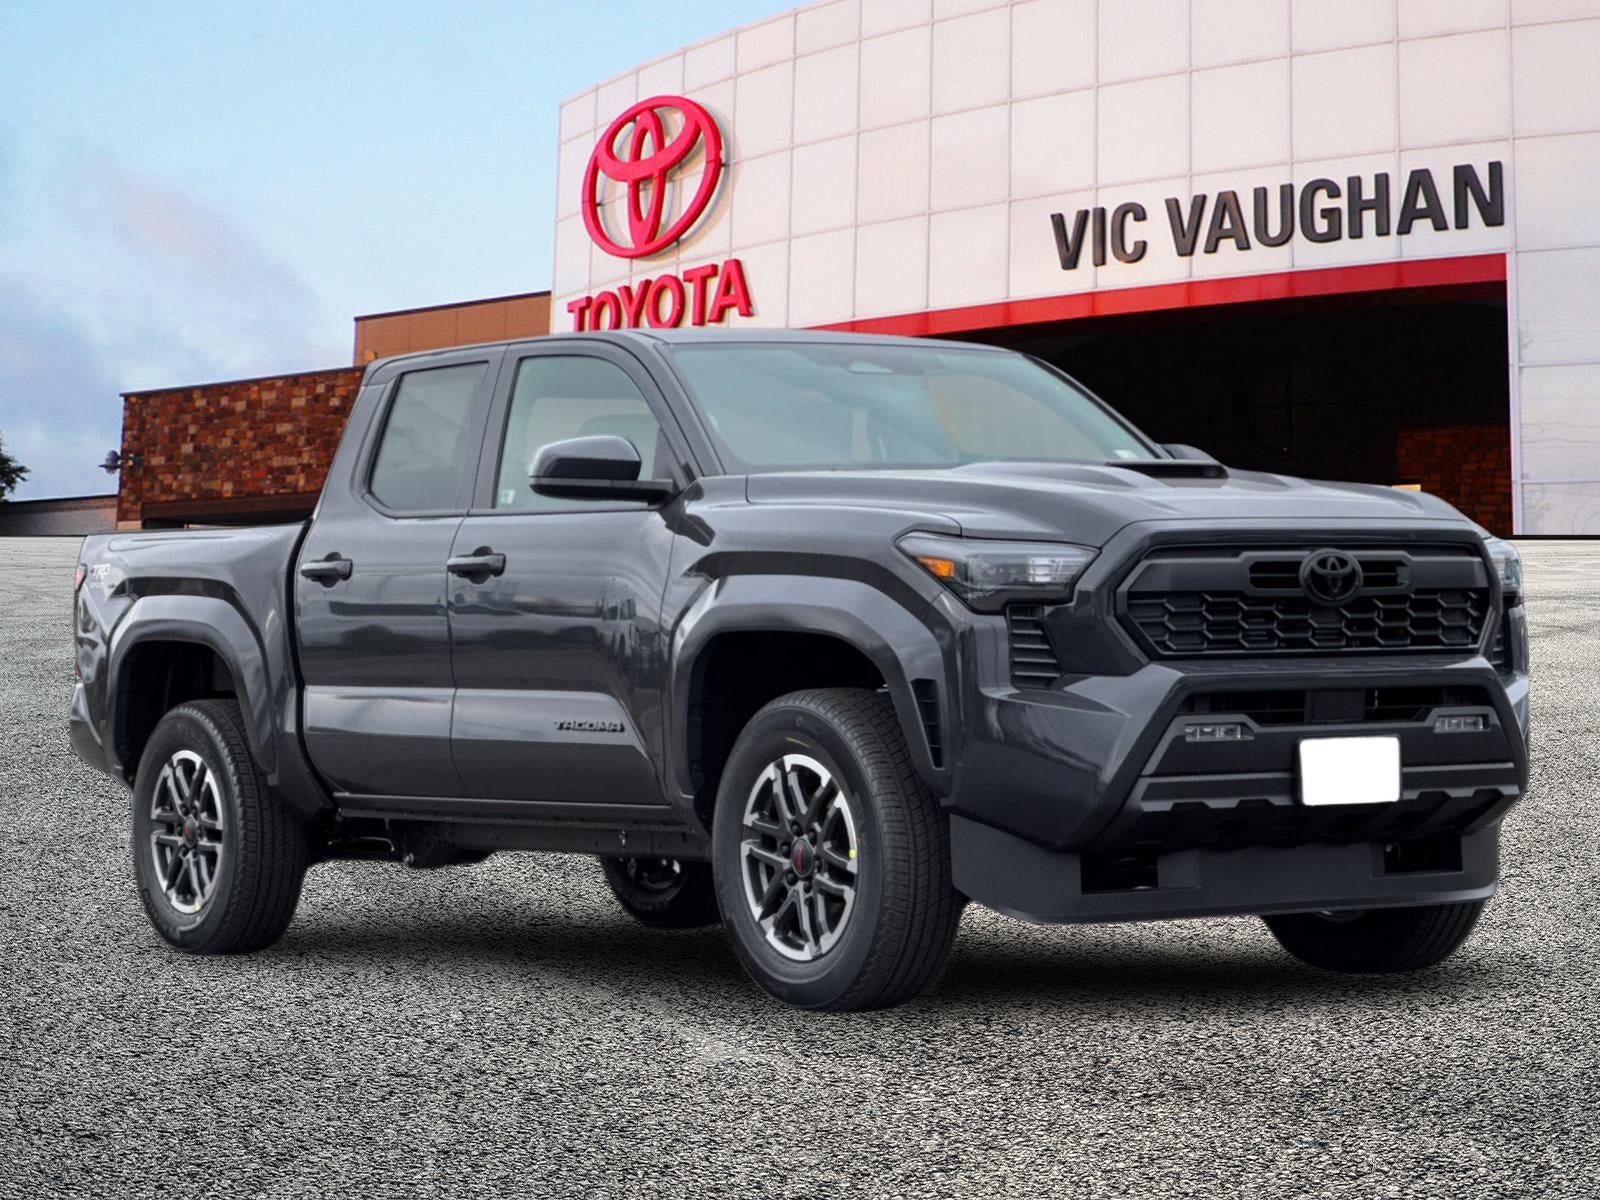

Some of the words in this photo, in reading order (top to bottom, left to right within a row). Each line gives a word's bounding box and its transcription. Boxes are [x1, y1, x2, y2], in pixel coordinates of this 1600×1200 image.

[1051, 202, 1147, 271] VIC
[1165, 161, 1505, 257] VAUGHAN
[567, 258, 754, 331] TOYOTA
[554, 720, 625, 733] TACOMA
